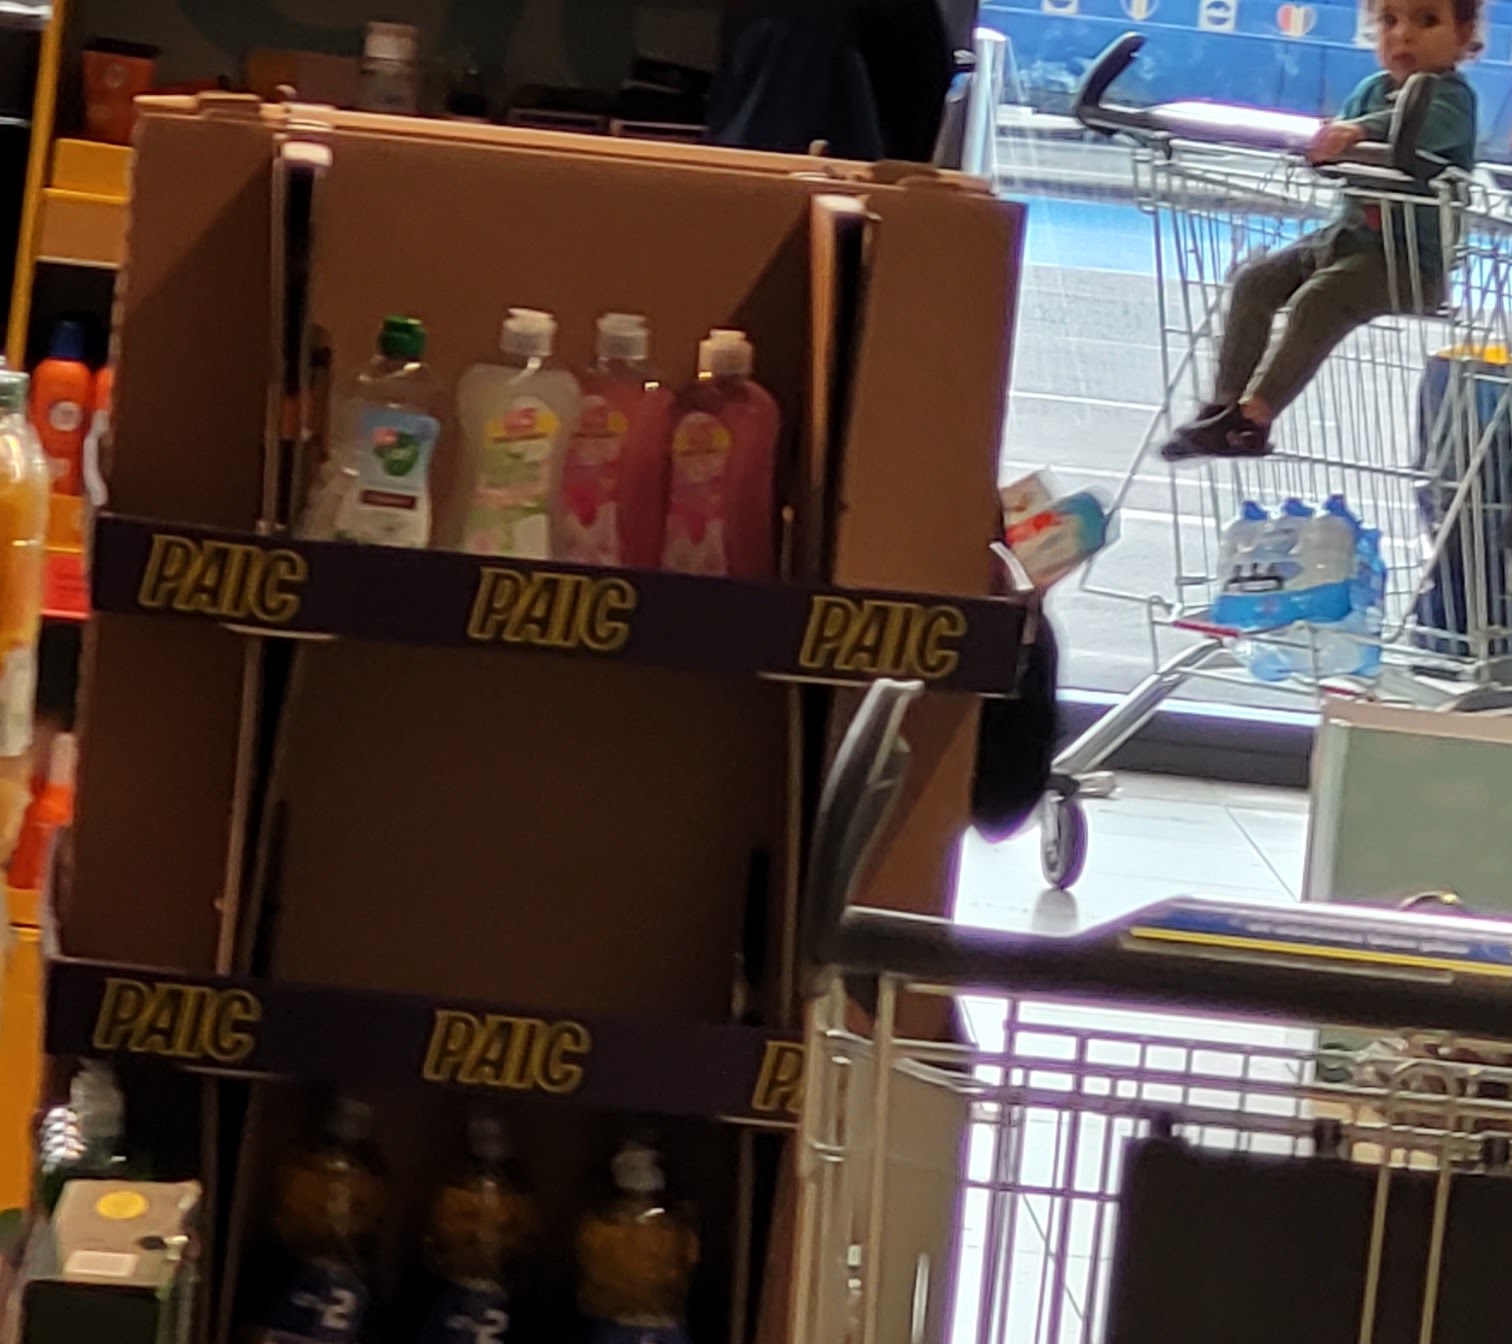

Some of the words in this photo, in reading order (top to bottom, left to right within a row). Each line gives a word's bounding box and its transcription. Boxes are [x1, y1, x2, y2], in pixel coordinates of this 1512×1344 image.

[139, 533, 309, 622] PAIC
[467, 567, 638, 653] PAIC
[800, 595, 968, 680] PAIC
[92, 977, 262, 1060] PAIC
[423, 1009, 592, 1094] PAIC
